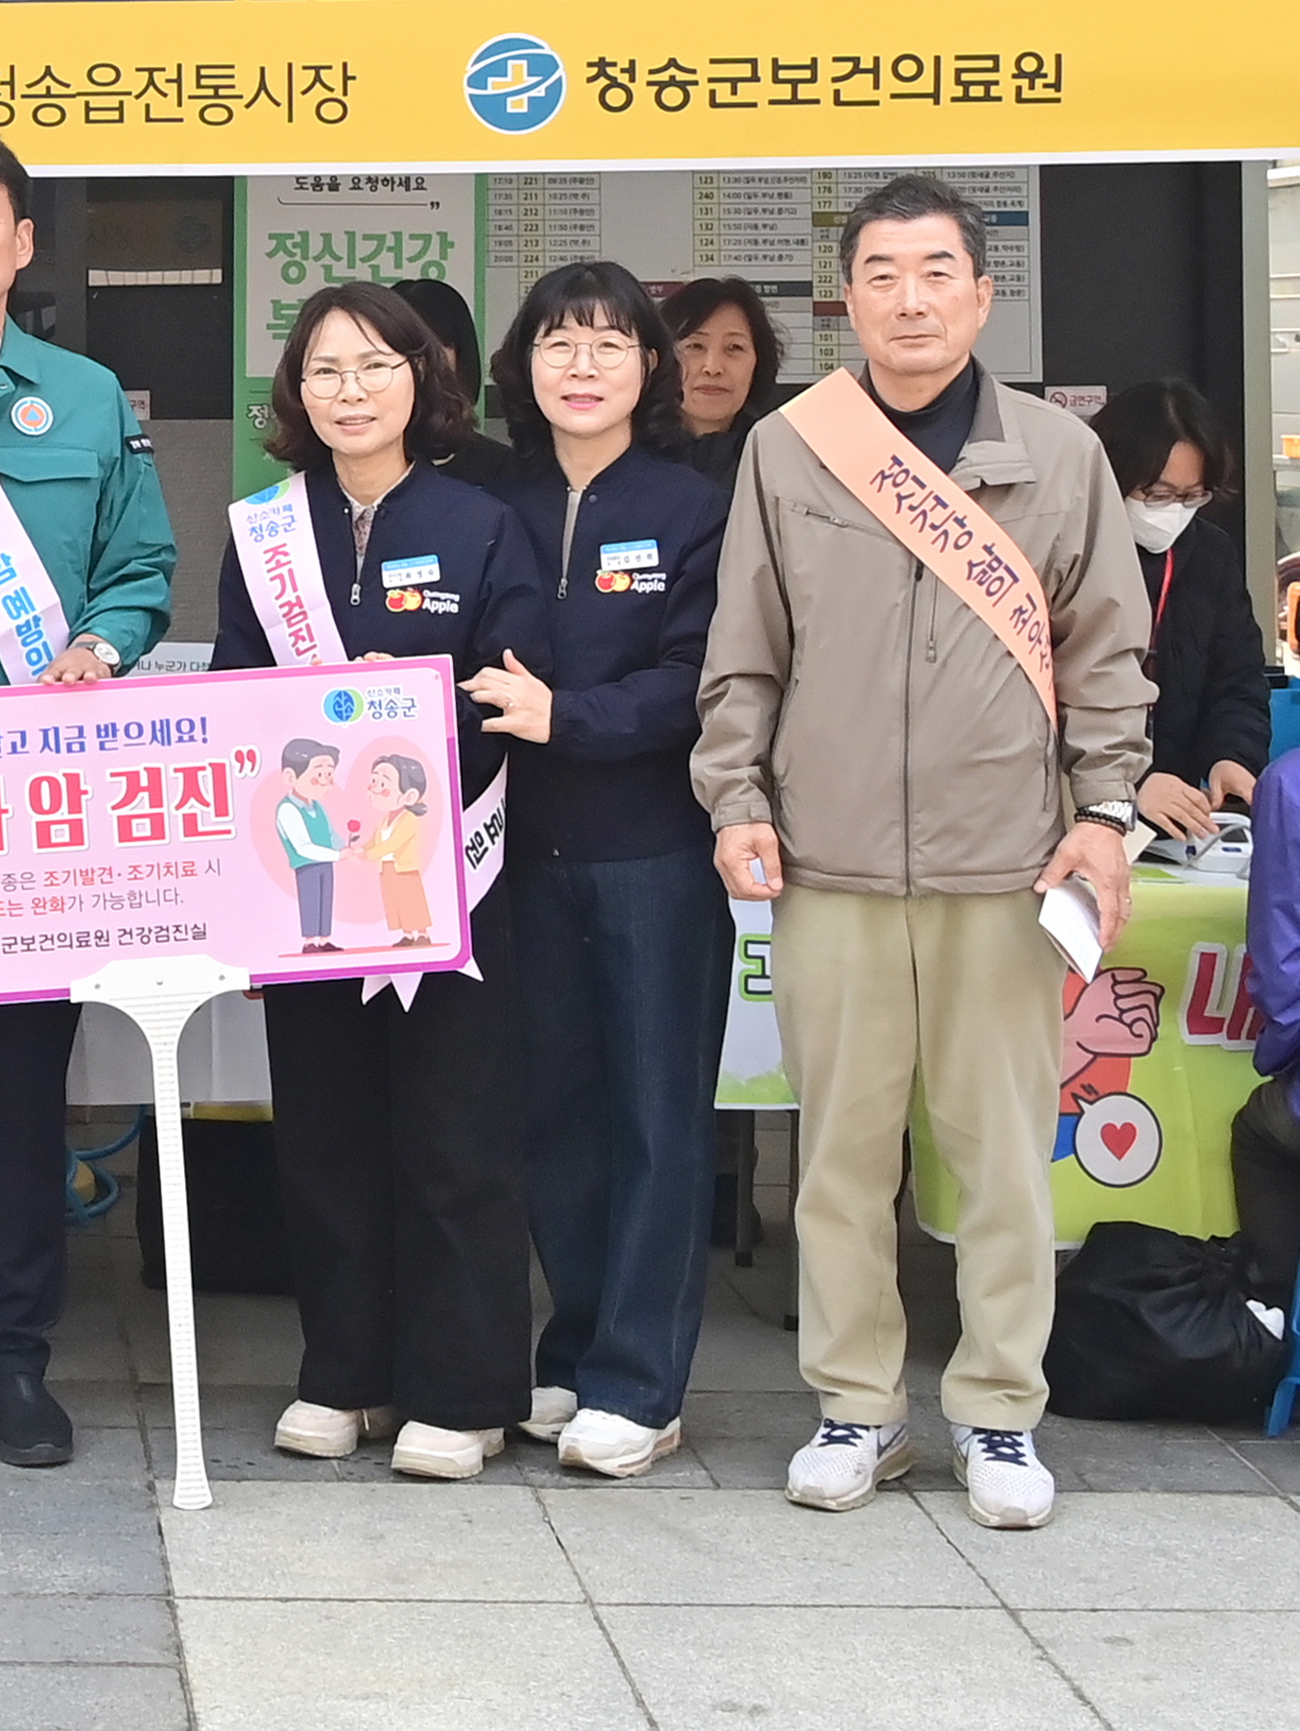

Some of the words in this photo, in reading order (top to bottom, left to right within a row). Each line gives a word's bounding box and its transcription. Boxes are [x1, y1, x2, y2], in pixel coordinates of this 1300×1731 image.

[586, 51, 1063, 113] 청송군보건의료원
[349, 175, 428, 192] 요청하세요
[523, 176, 538, 185] 221
[698, 176, 714, 185] 123
[817, 186, 832, 194] 176
[523, 192, 538, 201] 211
[698, 191, 714, 200] 240
[817, 200, 832, 209] 177
[523, 208, 539, 216] 212
[699, 207, 713, 215] 131
[523, 223, 539, 232] 223
[699, 222, 714, 231] 132
[523, 239, 539, 248] 213
[699, 238, 714, 246] 124
[818, 244, 833, 253] 120
[265, 230, 455, 287] 정신건강
[523, 254, 539, 263] 224
[699, 253, 715, 262] 134
[818, 260, 832, 269] 121
[817, 275, 833, 284] 222
[818, 289, 833, 298] 123
[818, 333, 833, 342] 101
[819, 347, 834, 356] 103
[869, 454, 976, 553] 정신건강
[248, 514, 297, 543] 청송군
[630, 579, 666, 594] Apple
[262, 542, 318, 660] 조기검진
[421, 597, 460, 615] Apple
[155, 661, 186, 672] 누군가
[367, 697, 418, 720] 청송군
[38, 724, 88, 755] 지금
[95, 716, 210, 752] 받으세요!
[27, 771, 89, 850] 암
[204, 858, 222, 877] 시
[31, 893, 84, 916] 완화가
[91, 886, 185, 912] 가능합니다.
[116, 922, 208, 947] 건강검진실
